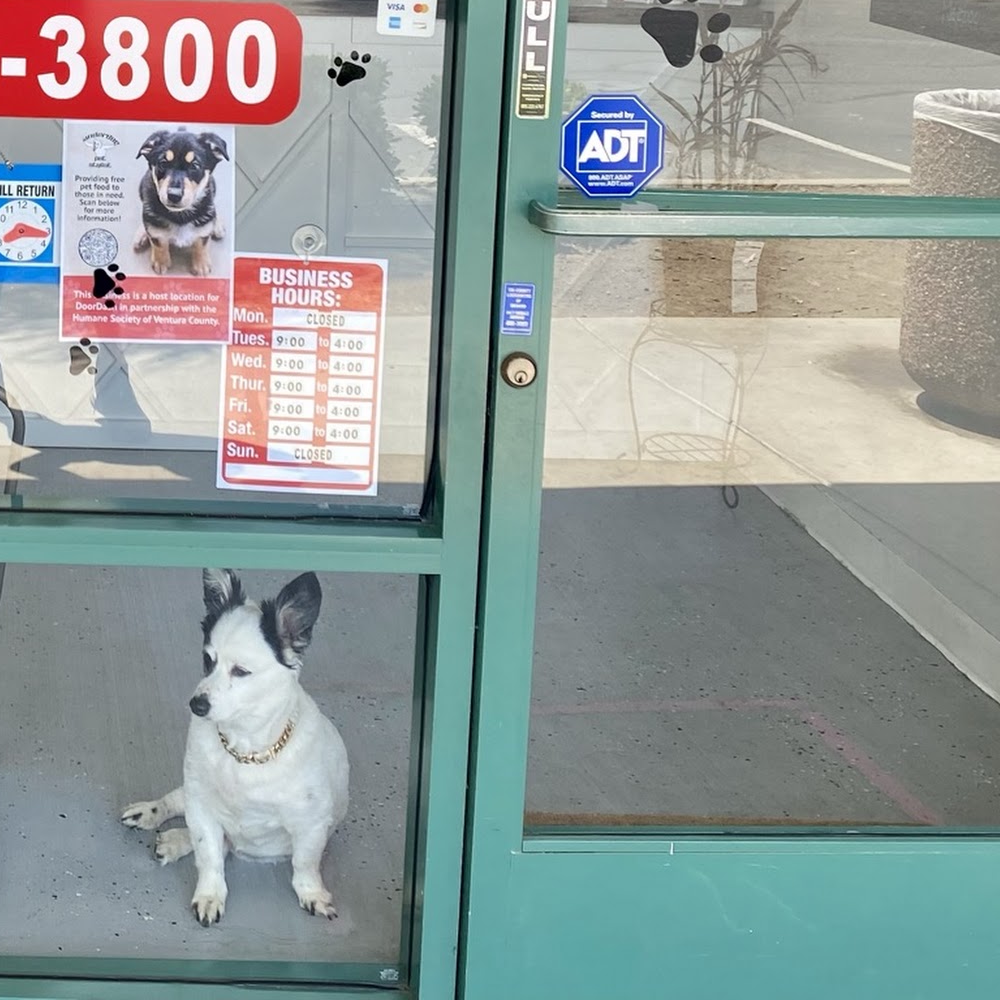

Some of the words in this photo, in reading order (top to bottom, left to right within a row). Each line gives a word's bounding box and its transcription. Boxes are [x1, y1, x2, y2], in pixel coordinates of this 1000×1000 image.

[386, 3, 405, 11] VISA
[590, 111, 623, 119] Secured
[624, 111, 635, 120] by
[578, 129, 646, 163] ADT
[75, 175, 109, 184] Providing
[111, 175, 125, 183] free
[16, 185, 55, 197] RETURN
[18, 201, 28, 209] 12
[41, 215, 47, 223] 2
[77, 214, 122, 222] information!
[40, 240, 46, 248] 4
[5, 249, 11, 257] 7
[17, 252, 23, 260] 6
[31, 250, 37, 258] 5
[259, 267, 354, 289] BUSINESS
[73, 290, 92, 299] This
[93, 291, 130, 300] siness
[133, 291, 140, 300] is
[149, 291, 168, 301] host
[170, 292, 205, 302] location
[207, 293, 220, 302] for
[271, 288, 342, 307] HOURS:
[75, 301, 118, 311] DoorDa
[119, 303, 128, 311] in
[130, 304, 179, 314] partnership
[181, 304, 200, 313] with
[202, 305, 217, 314] the
[72, 313, 108, 323] Humane
[110, 314, 141, 326] Society
[142, 315, 152, 323] of
[153, 316, 187, 325] Ventura
[188, 316, 220, 327] County.
[233, 307, 269, 324] Mon.
[306, 313, 345, 327] CLOSED
[232, 330, 269, 346] Tues.
[276, 335, 305, 348] 9:00
[319, 336, 329, 347] to
[334, 339, 363, 351] 4:00
[231, 352, 267, 369] Wed.
[275, 358, 304, 370] 9:00
[318, 359, 329, 370] to
[333, 361, 363, 373] 4:00
[230, 375, 266, 391] Thur.
[274, 381, 303, 392] 9:00
[317, 382, 327, 393] to
[332, 385, 361, 396] 4:00
[229, 398, 252, 413] Fri.
[274, 403, 302, 415] 9:00
[315, 404, 327, 415] to
[331, 406, 360, 418] 4:00
[227, 420, 256, 435] Sat.
[272, 425, 301, 436] 9:00
[315, 426, 325, 437] to
[330, 429, 359, 440] 4:00
[226, 442, 259, 459] Sun.
[294, 448, 333, 461] CLOSED
